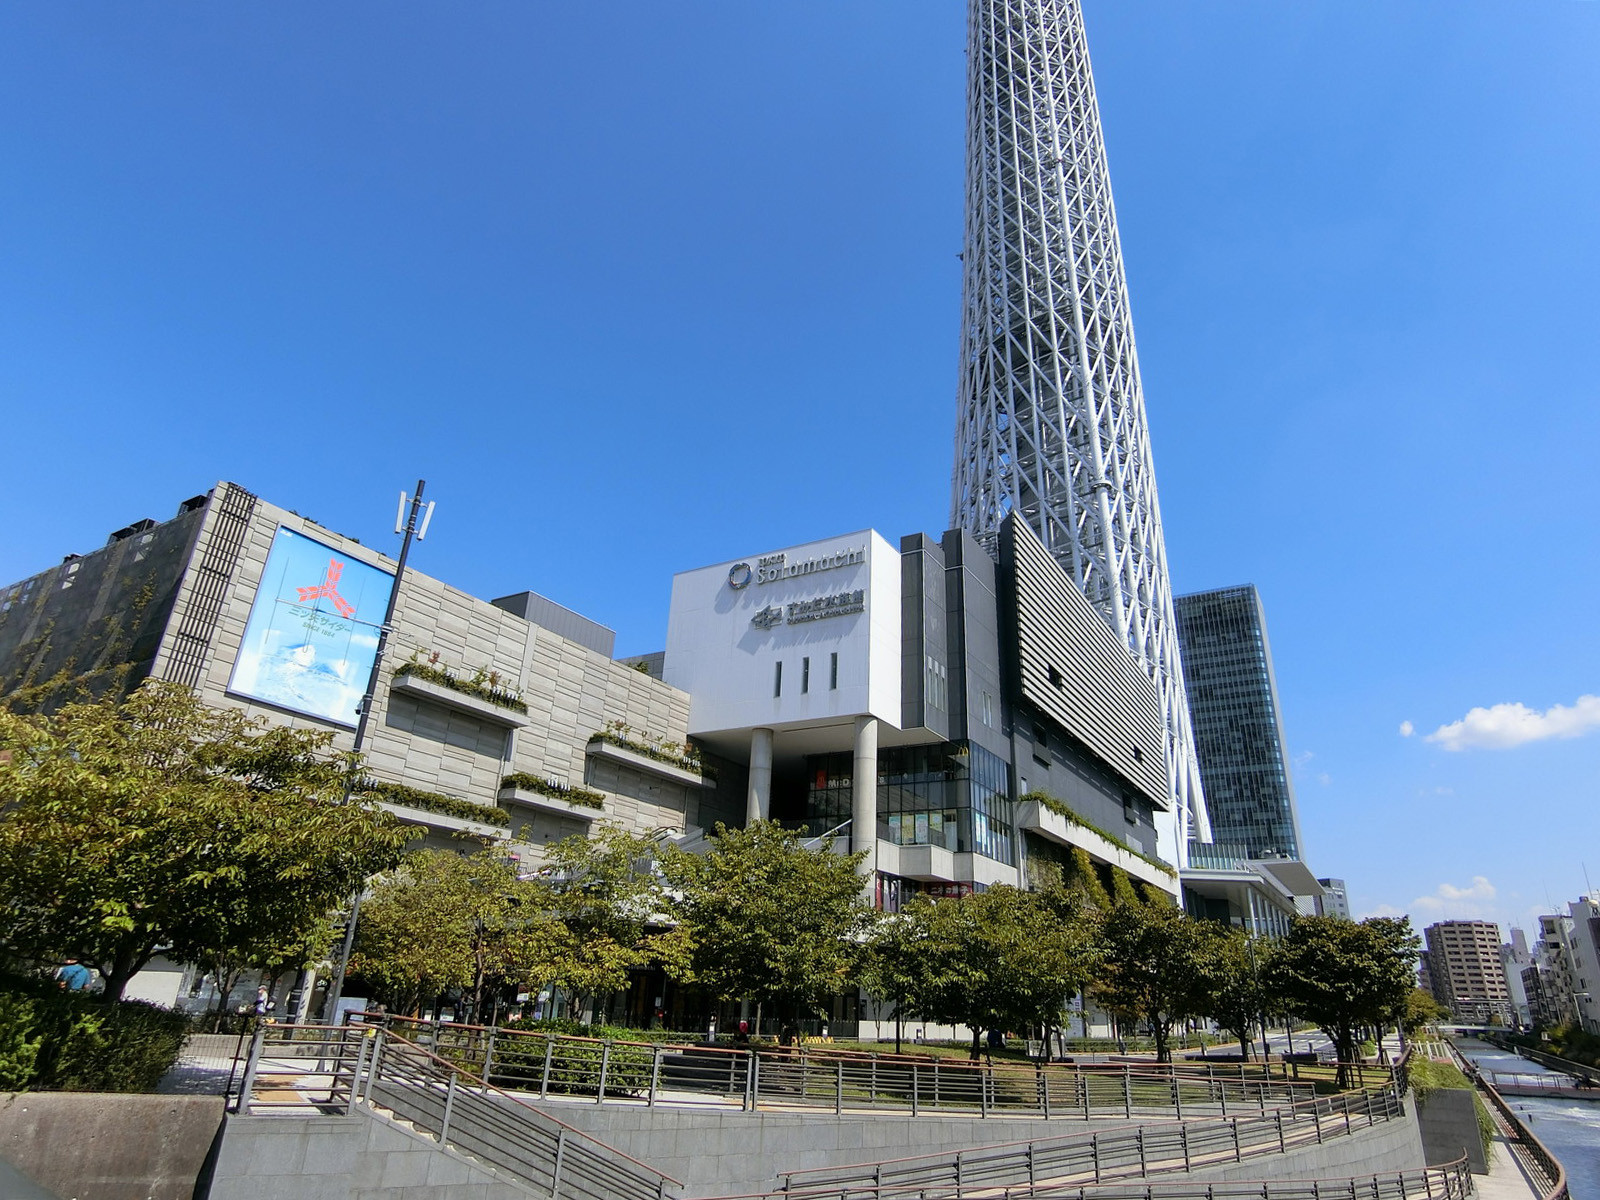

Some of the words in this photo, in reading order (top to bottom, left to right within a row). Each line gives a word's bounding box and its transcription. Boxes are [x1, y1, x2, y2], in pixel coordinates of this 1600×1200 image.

[756, 544, 867, 585] Solamachi
[287, 604, 351, 632] 三ツ矢サイダー
